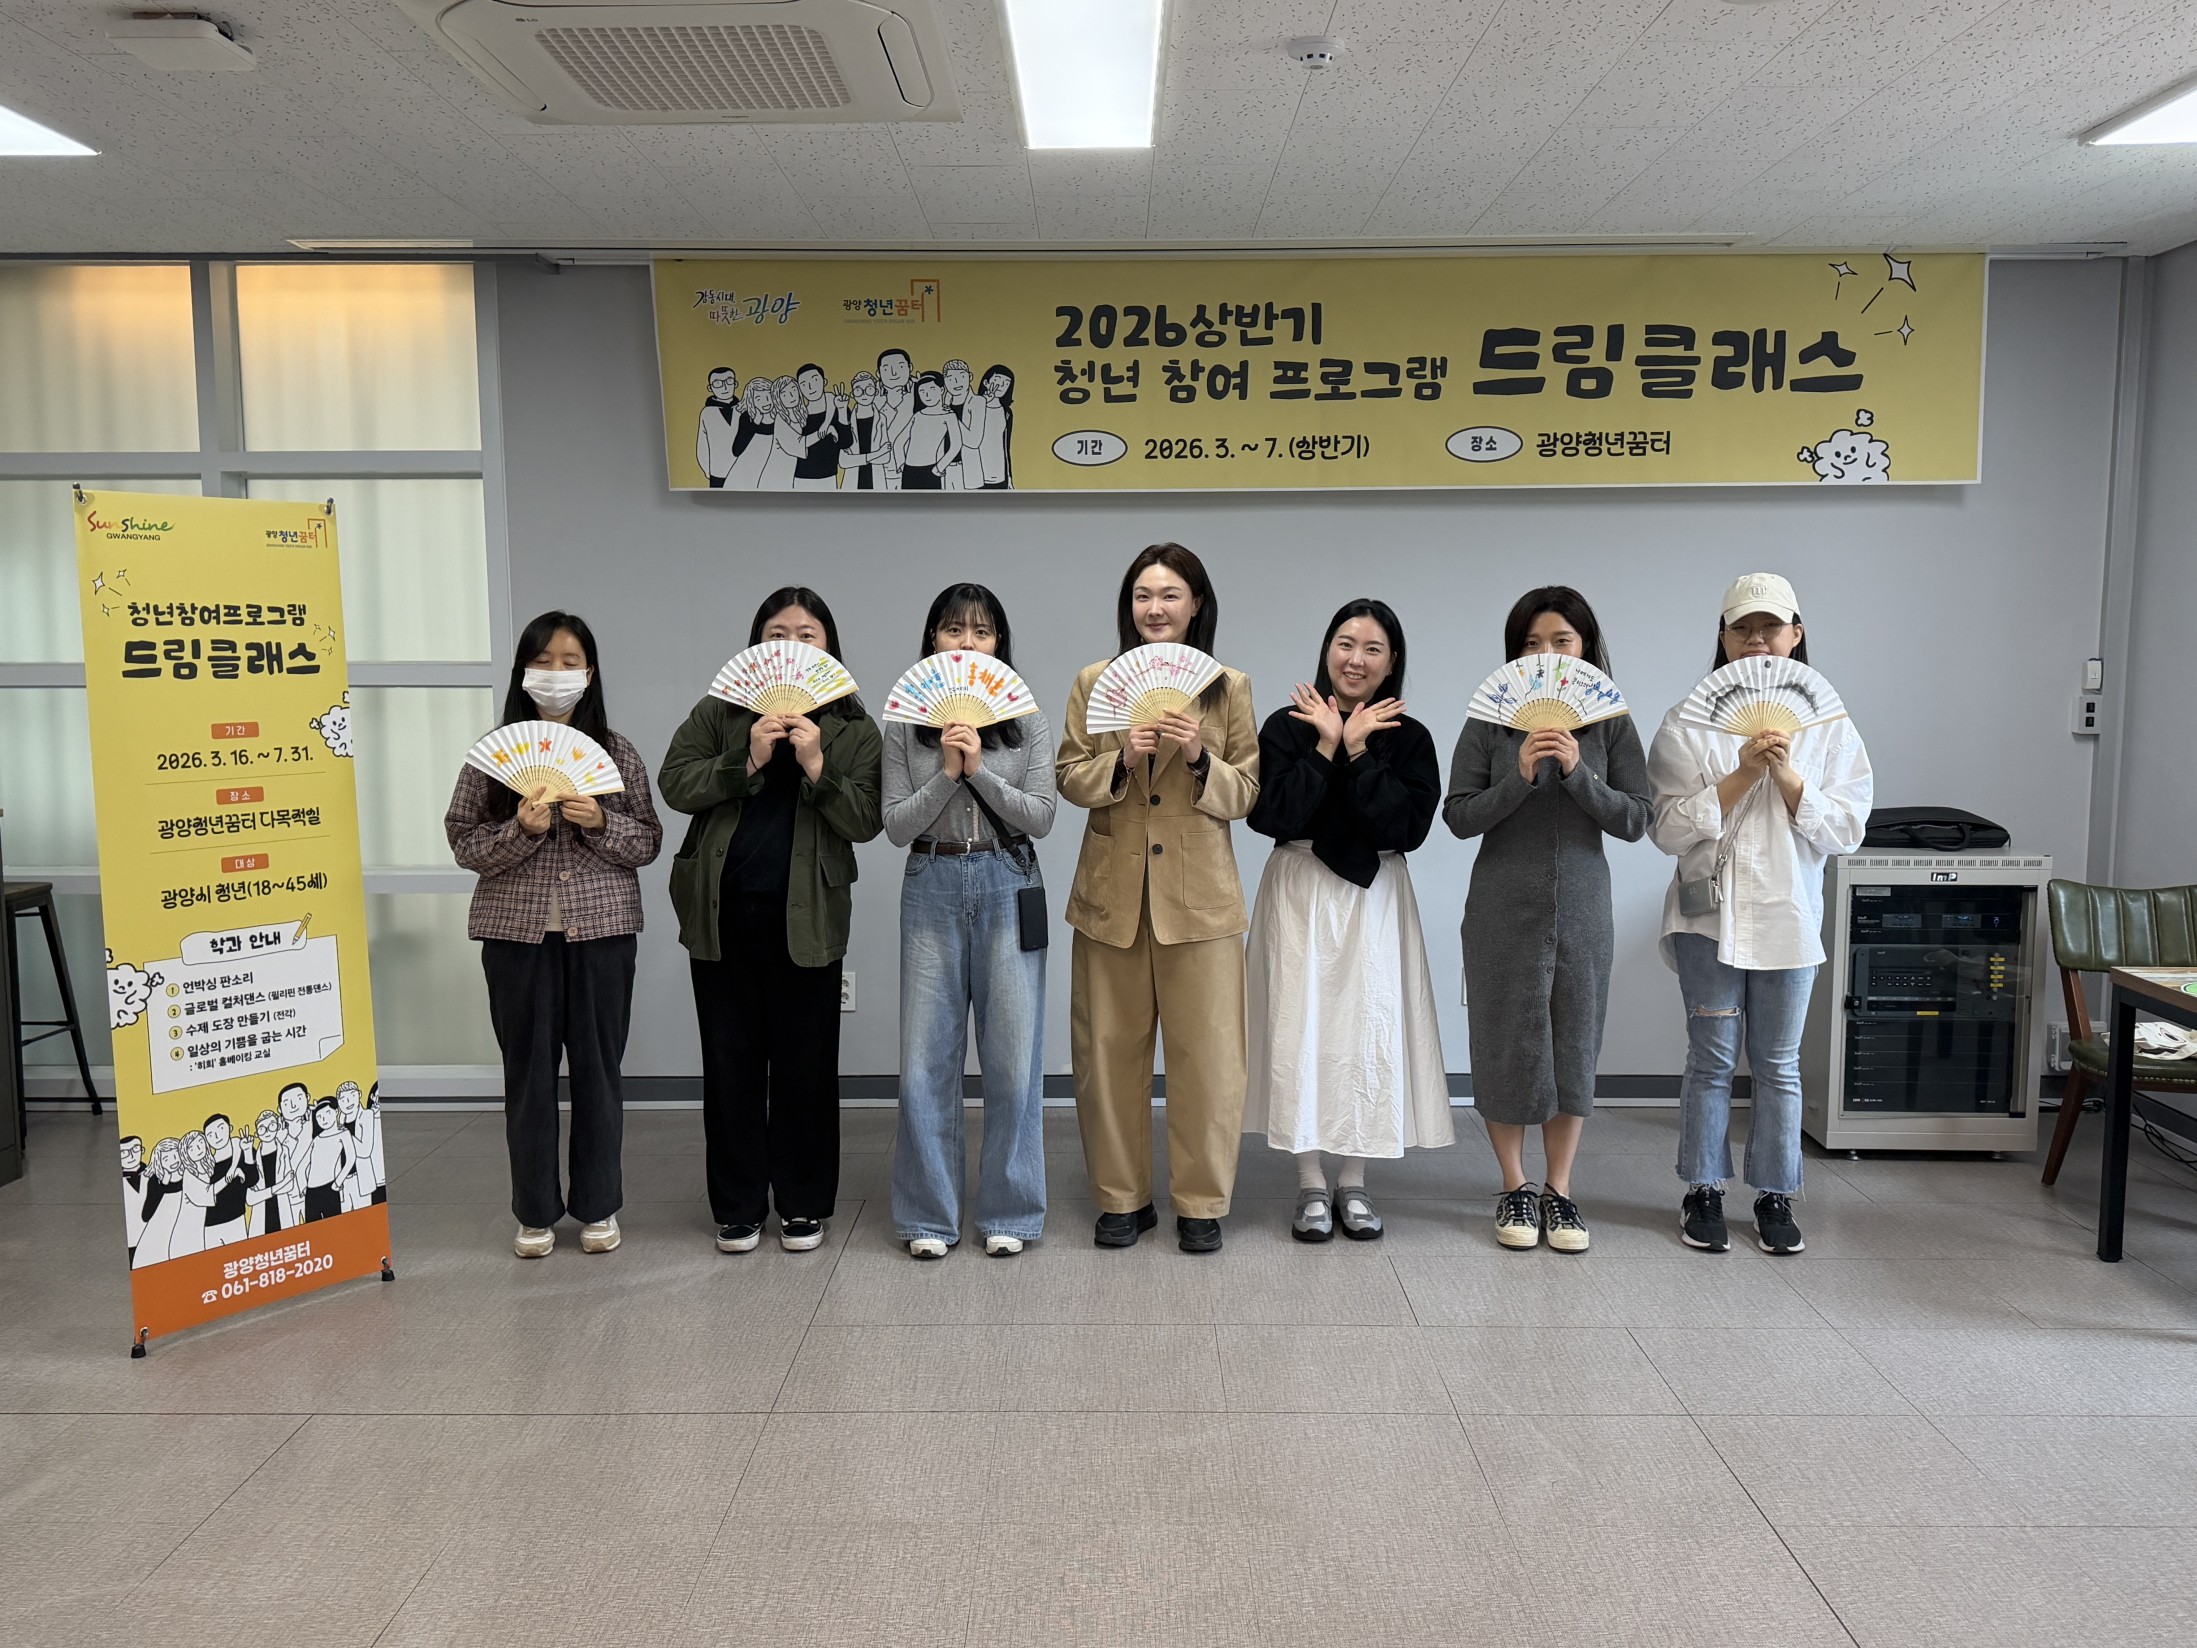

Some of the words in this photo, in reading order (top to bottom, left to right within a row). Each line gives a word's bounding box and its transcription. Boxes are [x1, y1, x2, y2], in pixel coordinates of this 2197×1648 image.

[709, 305, 743, 325] 따뜻한
[743, 292, 800, 324] 광양
[842, 299, 861, 311] 광양
[1055, 302, 1322, 348] 2026상반기
[1473, 324, 1864, 399] 드림클래스
[1054, 358, 1140, 404] 청년
[1162, 358, 1249, 404] 참여
[1269, 356, 1448, 401] 프로그램
[1076, 439, 1103, 456] 기간
[1471, 435, 1498, 452] 장소
[1536, 431, 1671, 457] 광양청년꿈터
[106, 532, 161, 541] GWANGYANG
[127, 602, 307, 627] 청년참여프로그램
[122, 639, 321, 680] 드림클래스
[225, 725, 246, 736] 기간
[158, 812, 257, 840] 광양청년꿈터
[260, 806, 322, 828] 다목적실
[235, 858, 255, 869] 대상
[160, 885, 211, 910] 광양시
[215, 872, 328, 903] 청년(18~45세)
[209, 935, 242, 954] 학과
[249, 931, 281, 950] 안내
[183, 977, 217, 995] 언박싱
[219, 972, 254, 988] 판소리
[184, 998, 219, 1016] 글로벌
[221, 990, 266, 1009] 컬처댄스
[267, 987, 296, 1002] (필리핀
[297, 982, 332, 997] 전통댄스)
[186, 1022, 209, 1037] 수제
[211, 1017, 234, 1031] 도장
[237, 1010, 270, 1028] 만들기
[273, 1008, 296, 1022] (전각)
[187, 1040, 222, 1058] 일상의
[224, 1033, 258, 1050] 기쁨을
[261, 1029, 282, 1046] 굽는
[285, 1025, 307, 1039] 시간
[218, 1051, 252, 1067] 홈베이킹
[254, 1048, 271, 1060] 교실
[223, 1240, 311, 1279] 광양청년꿈터
[221, 1254, 334, 1299] 061-818-2020
